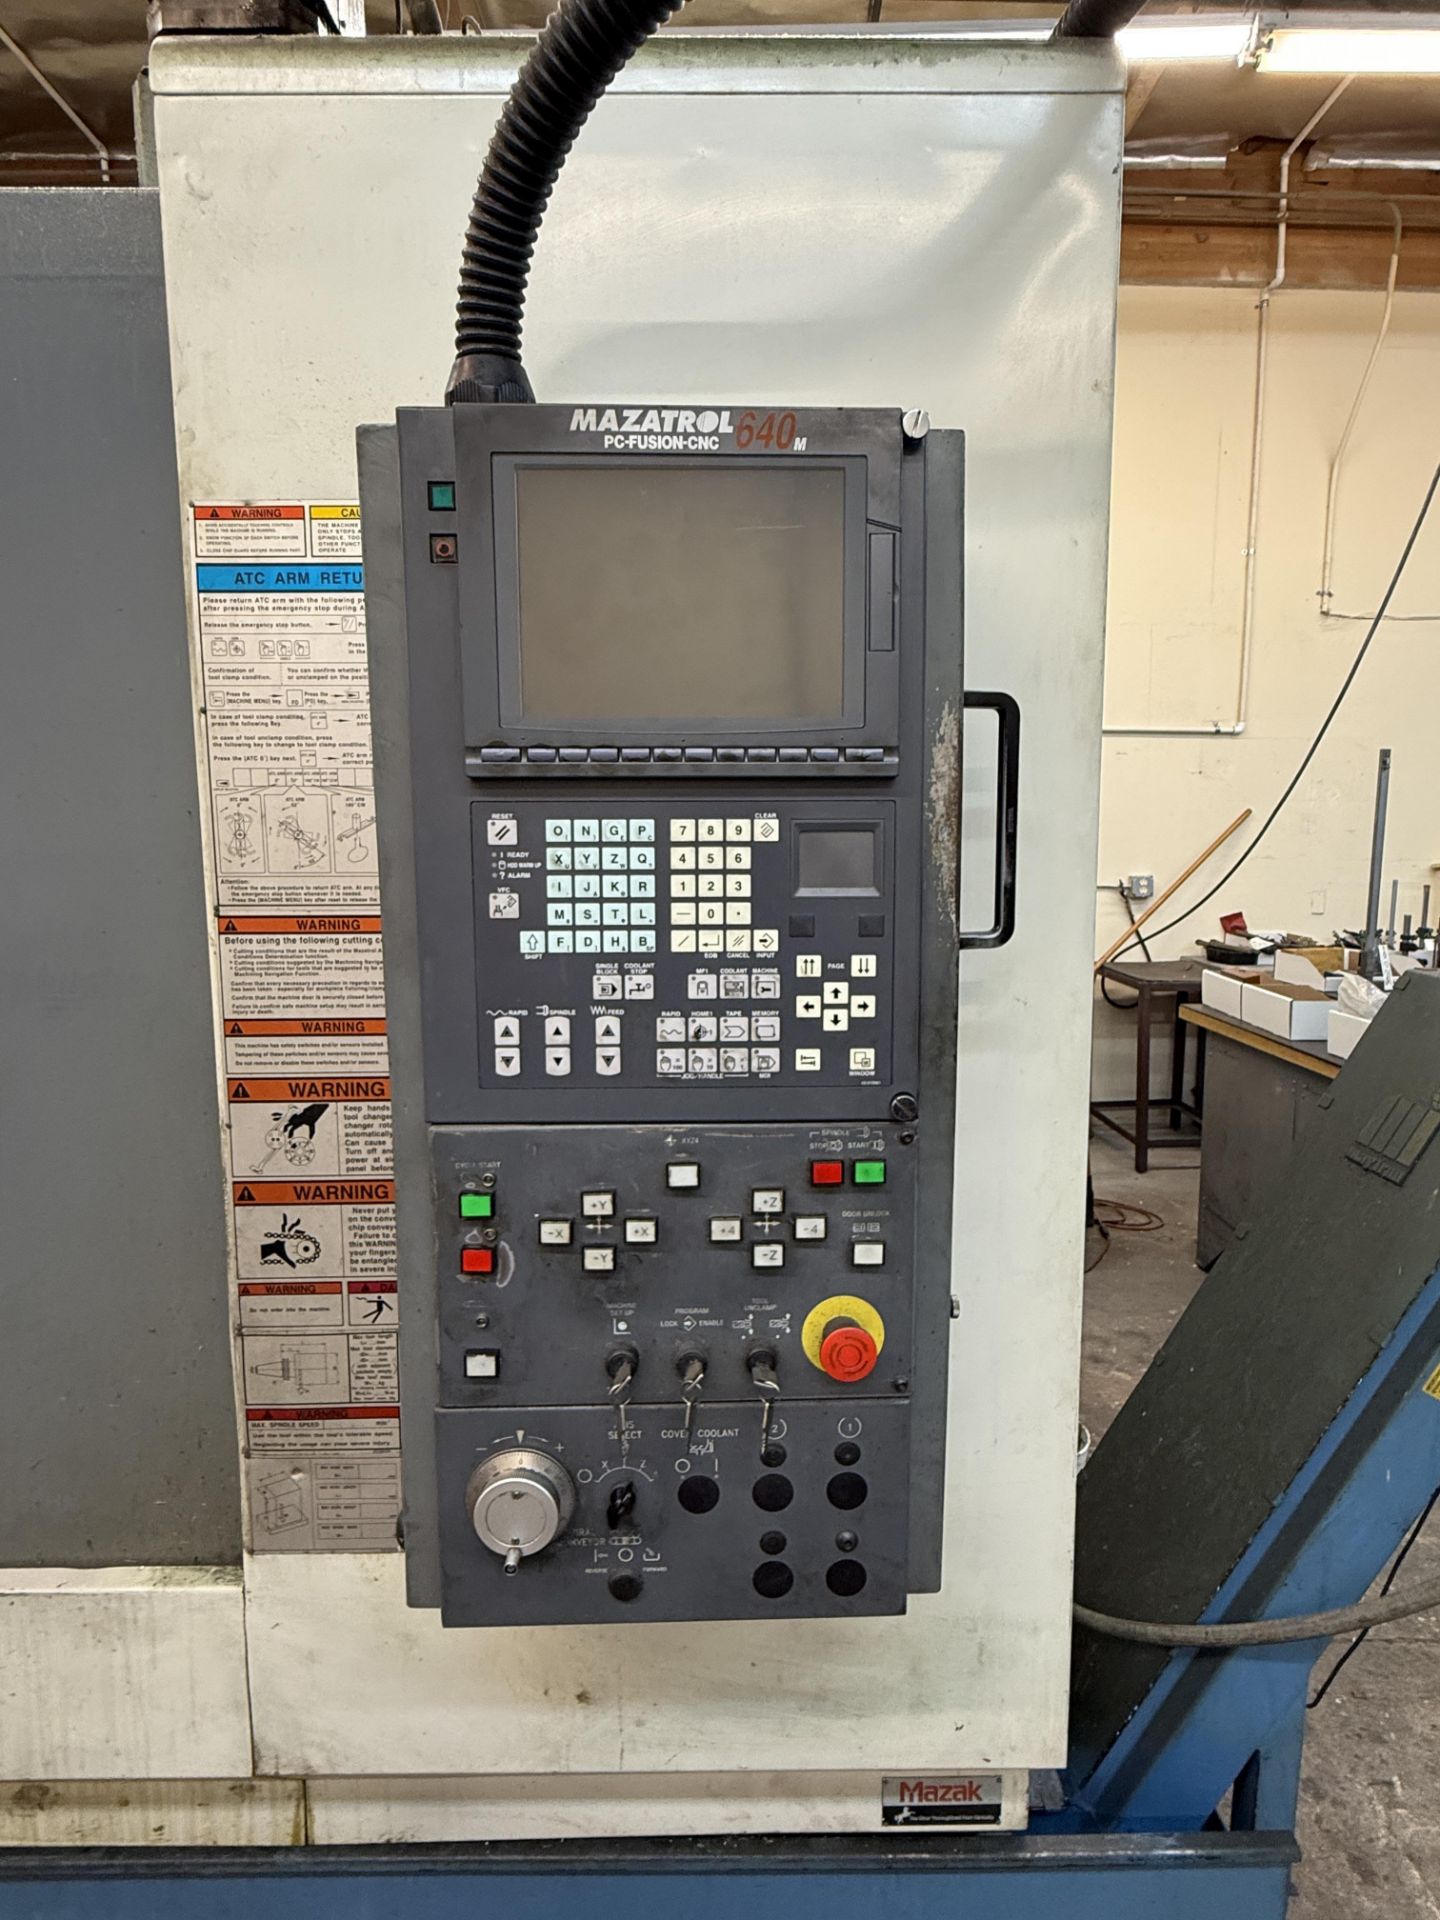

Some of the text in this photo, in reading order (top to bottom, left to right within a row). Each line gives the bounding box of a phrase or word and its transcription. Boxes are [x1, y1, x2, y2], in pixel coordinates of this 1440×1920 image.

[570, 409, 733, 433] MAZATROL
[736, 410, 807, 451] 640 M
[604, 435, 719, 450] PC-FUSION-CNC
[232, 509, 282, 517] WARNING
[235, 572, 264, 584] ATC
[275, 572, 309, 584] ARM
[582, 826, 590, 835] N
[610, 826, 618, 835] G
[638, 826, 646, 835] P
[680, 826, 687, 835] 7
[707, 826, 714, 835] 8
[735, 825, 742, 835] 9
[554, 855, 562, 864] X
[583, 854, 590, 863] Y
[611, 854, 619, 864] Z
[638, 853, 647, 864] Q
[679, 854, 686, 863] 4
[707, 854, 714, 863] 5
[735, 853, 742, 863] 6
[584, 882, 590, 892] J
[611, 882, 620, 892] K
[639, 882, 647, 891] R
[681, 881, 686, 891] 1
[708, 881, 714, 891] 2
[735, 881, 742, 891] 3
[555, 910, 564, 919] M
[584, 909, 592, 919] S
[611, 909, 620, 920] T
[640, 909, 647, 919] L
[296, 920, 361, 930] WARNING
[256, 938, 280, 946] using
[300, 937, 339, 945] following
[342, 937, 372, 945] cutting
[557, 937, 564, 947] F
[584, 937, 592, 947] D
[611, 937, 619, 946] H
[639, 937, 648, 946] B
[550, 1008, 576, 1016] SPINDLE
[301, 1022, 365, 1032] WARNING
[289, 1082, 385, 1097] WARNING
[848, 1141, 869, 1149] START
[346, 1165, 366, 1173] panel
[294, 1184, 389, 1200] WARNING
[592, 1201, 606, 1210] +Y
[762, 1197, 777, 1208] +Z
[548, 1225, 818, 1238] -X +X +4 -4
[594, 1250, 777, 1263] -Y -Z
[265, 1285, 316, 1294] WARNING
[296, 1409, 348, 1419] WARNING
[608, 1430, 642, 1439] SEECT
[697, 1429, 739, 1437] COOLANT
[772, 1425, 778, 1433] 2
[601, 1460, 646, 1469] X Z
[899, 1780, 982, 1803] Mazak
